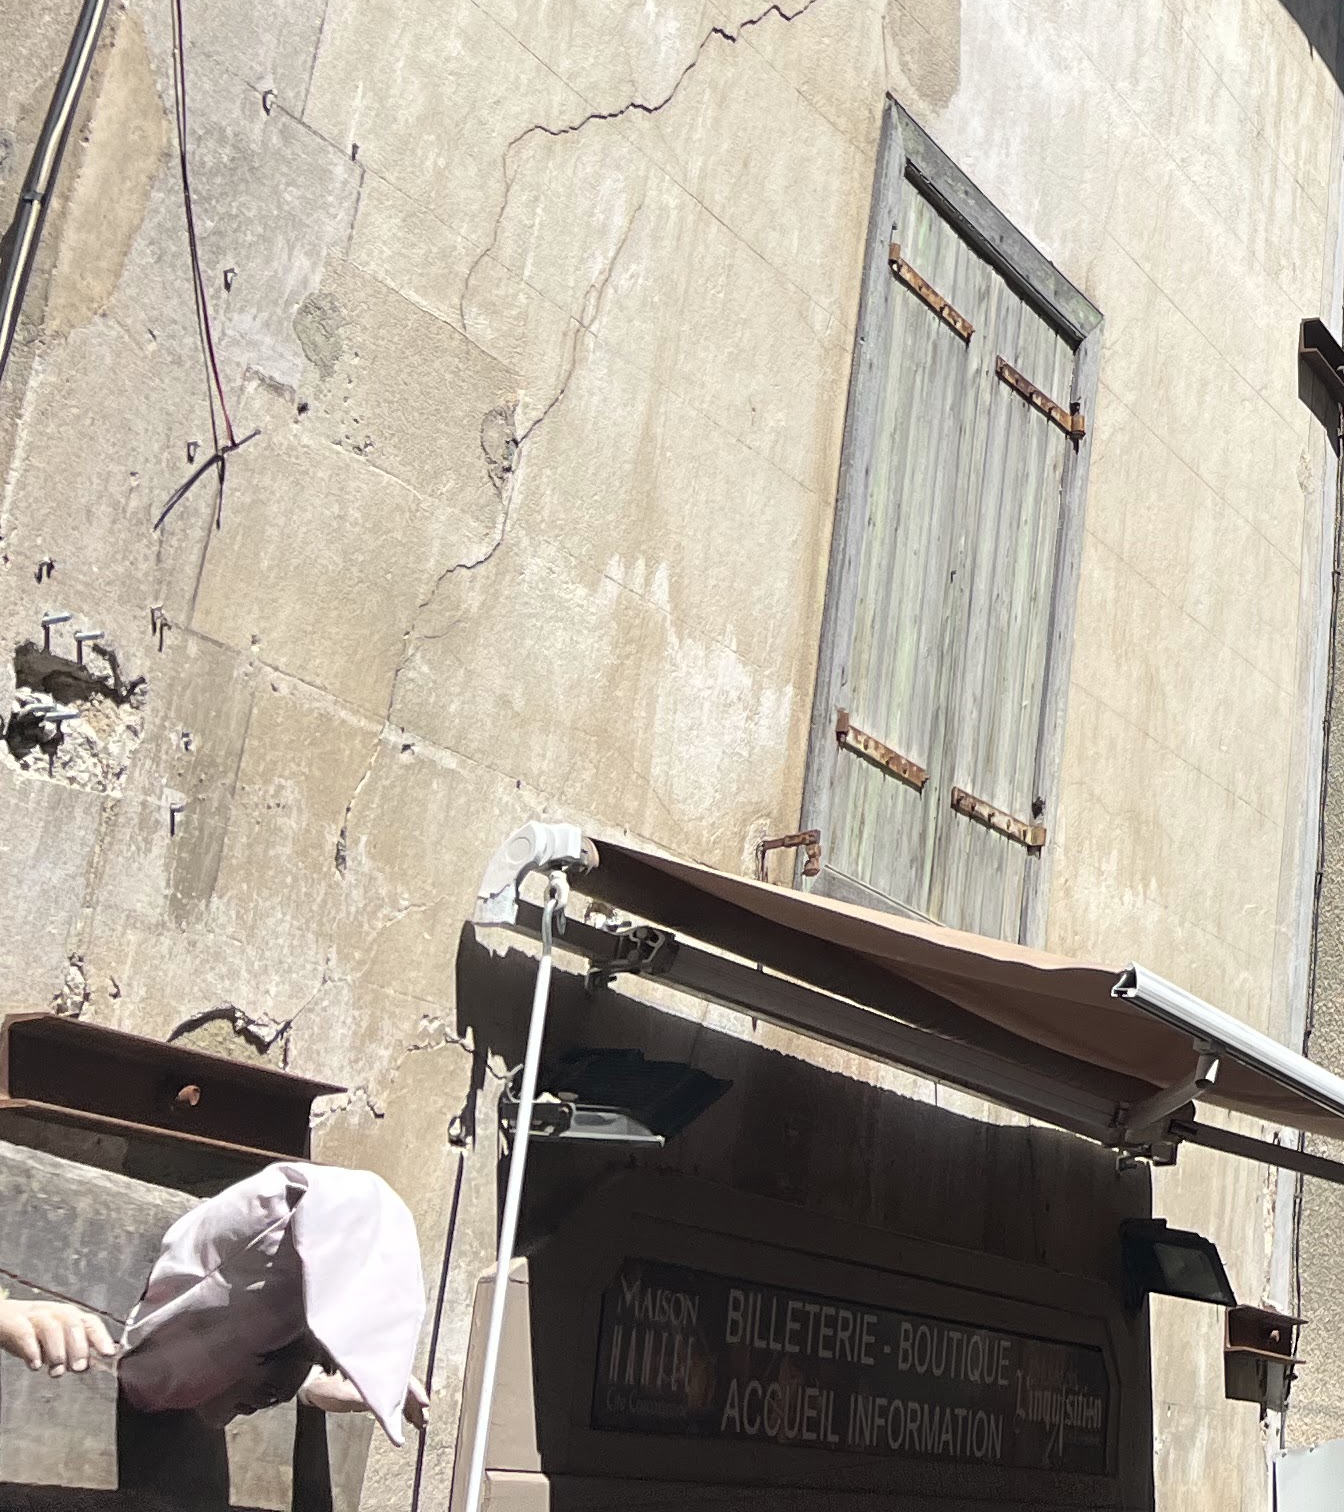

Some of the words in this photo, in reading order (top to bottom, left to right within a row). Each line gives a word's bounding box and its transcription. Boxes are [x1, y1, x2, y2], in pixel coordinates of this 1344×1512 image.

[616, 1275, 700, 1328] MAISON
[725, 1287, 878, 1366] BILLETERIE
[898, 1321, 1012, 1386] BOUTIQUE
[720, 1377, 840, 1444] ACCUEIL
[848, 1392, 1006, 1460] INFORMATION
